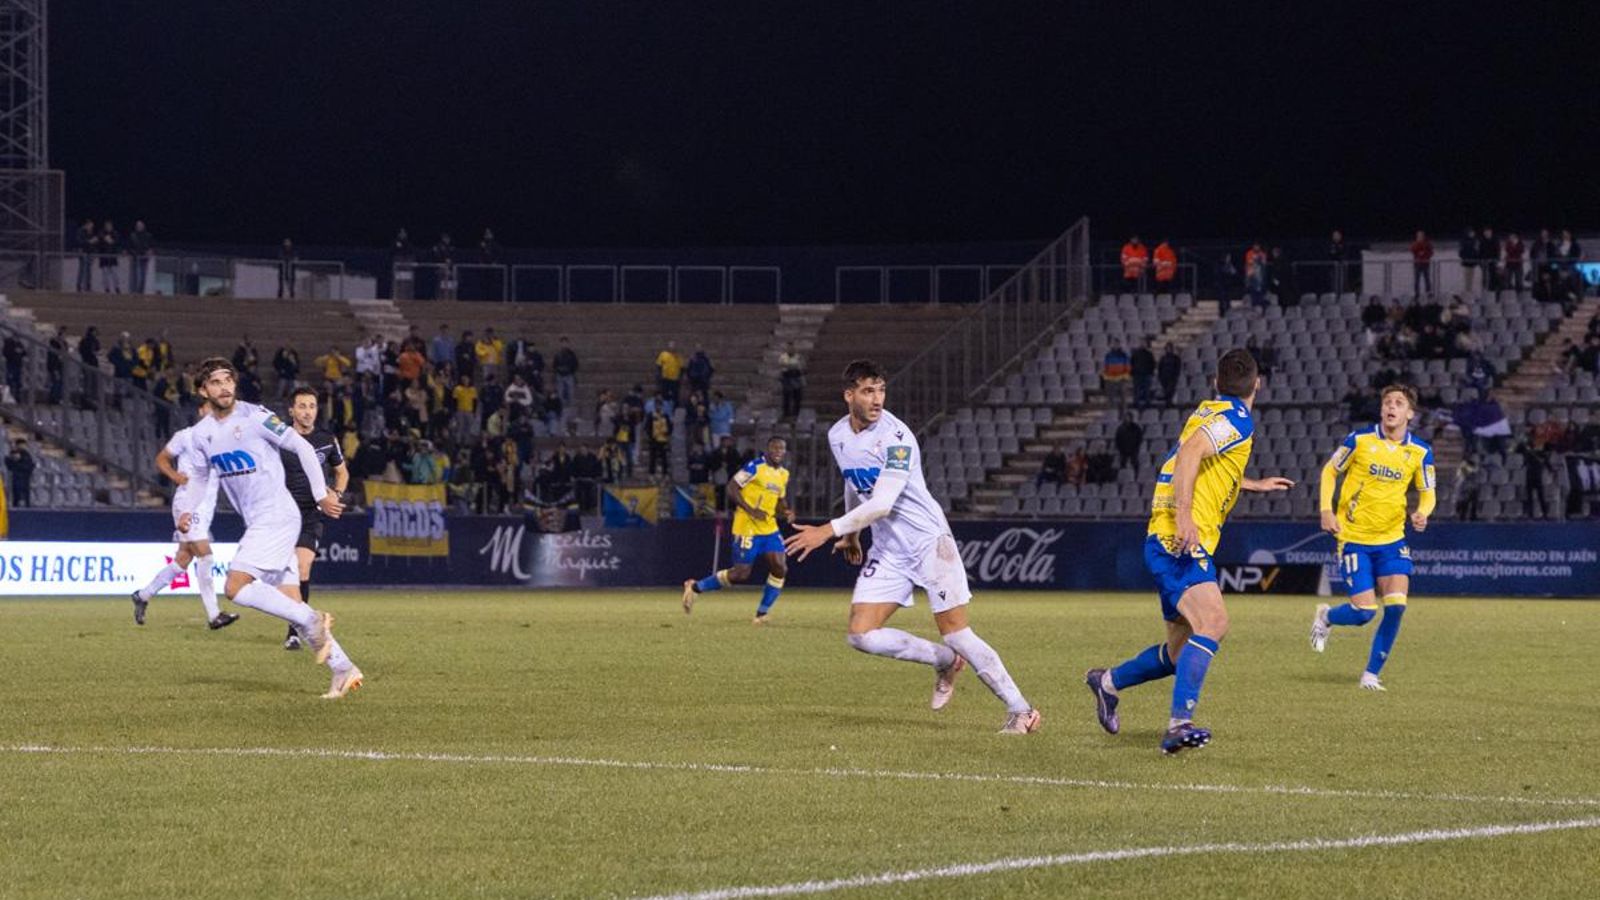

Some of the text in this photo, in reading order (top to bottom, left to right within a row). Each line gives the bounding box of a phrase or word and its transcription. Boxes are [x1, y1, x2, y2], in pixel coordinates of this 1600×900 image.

[329, 543, 359, 562] Orta
[1412, 550, 1469, 562] DESGUACE
[1472, 550, 1547, 562] AUTORIZADO
[1550, 551, 1565, 562] EN
[1344, 552, 1359, 575] 11
